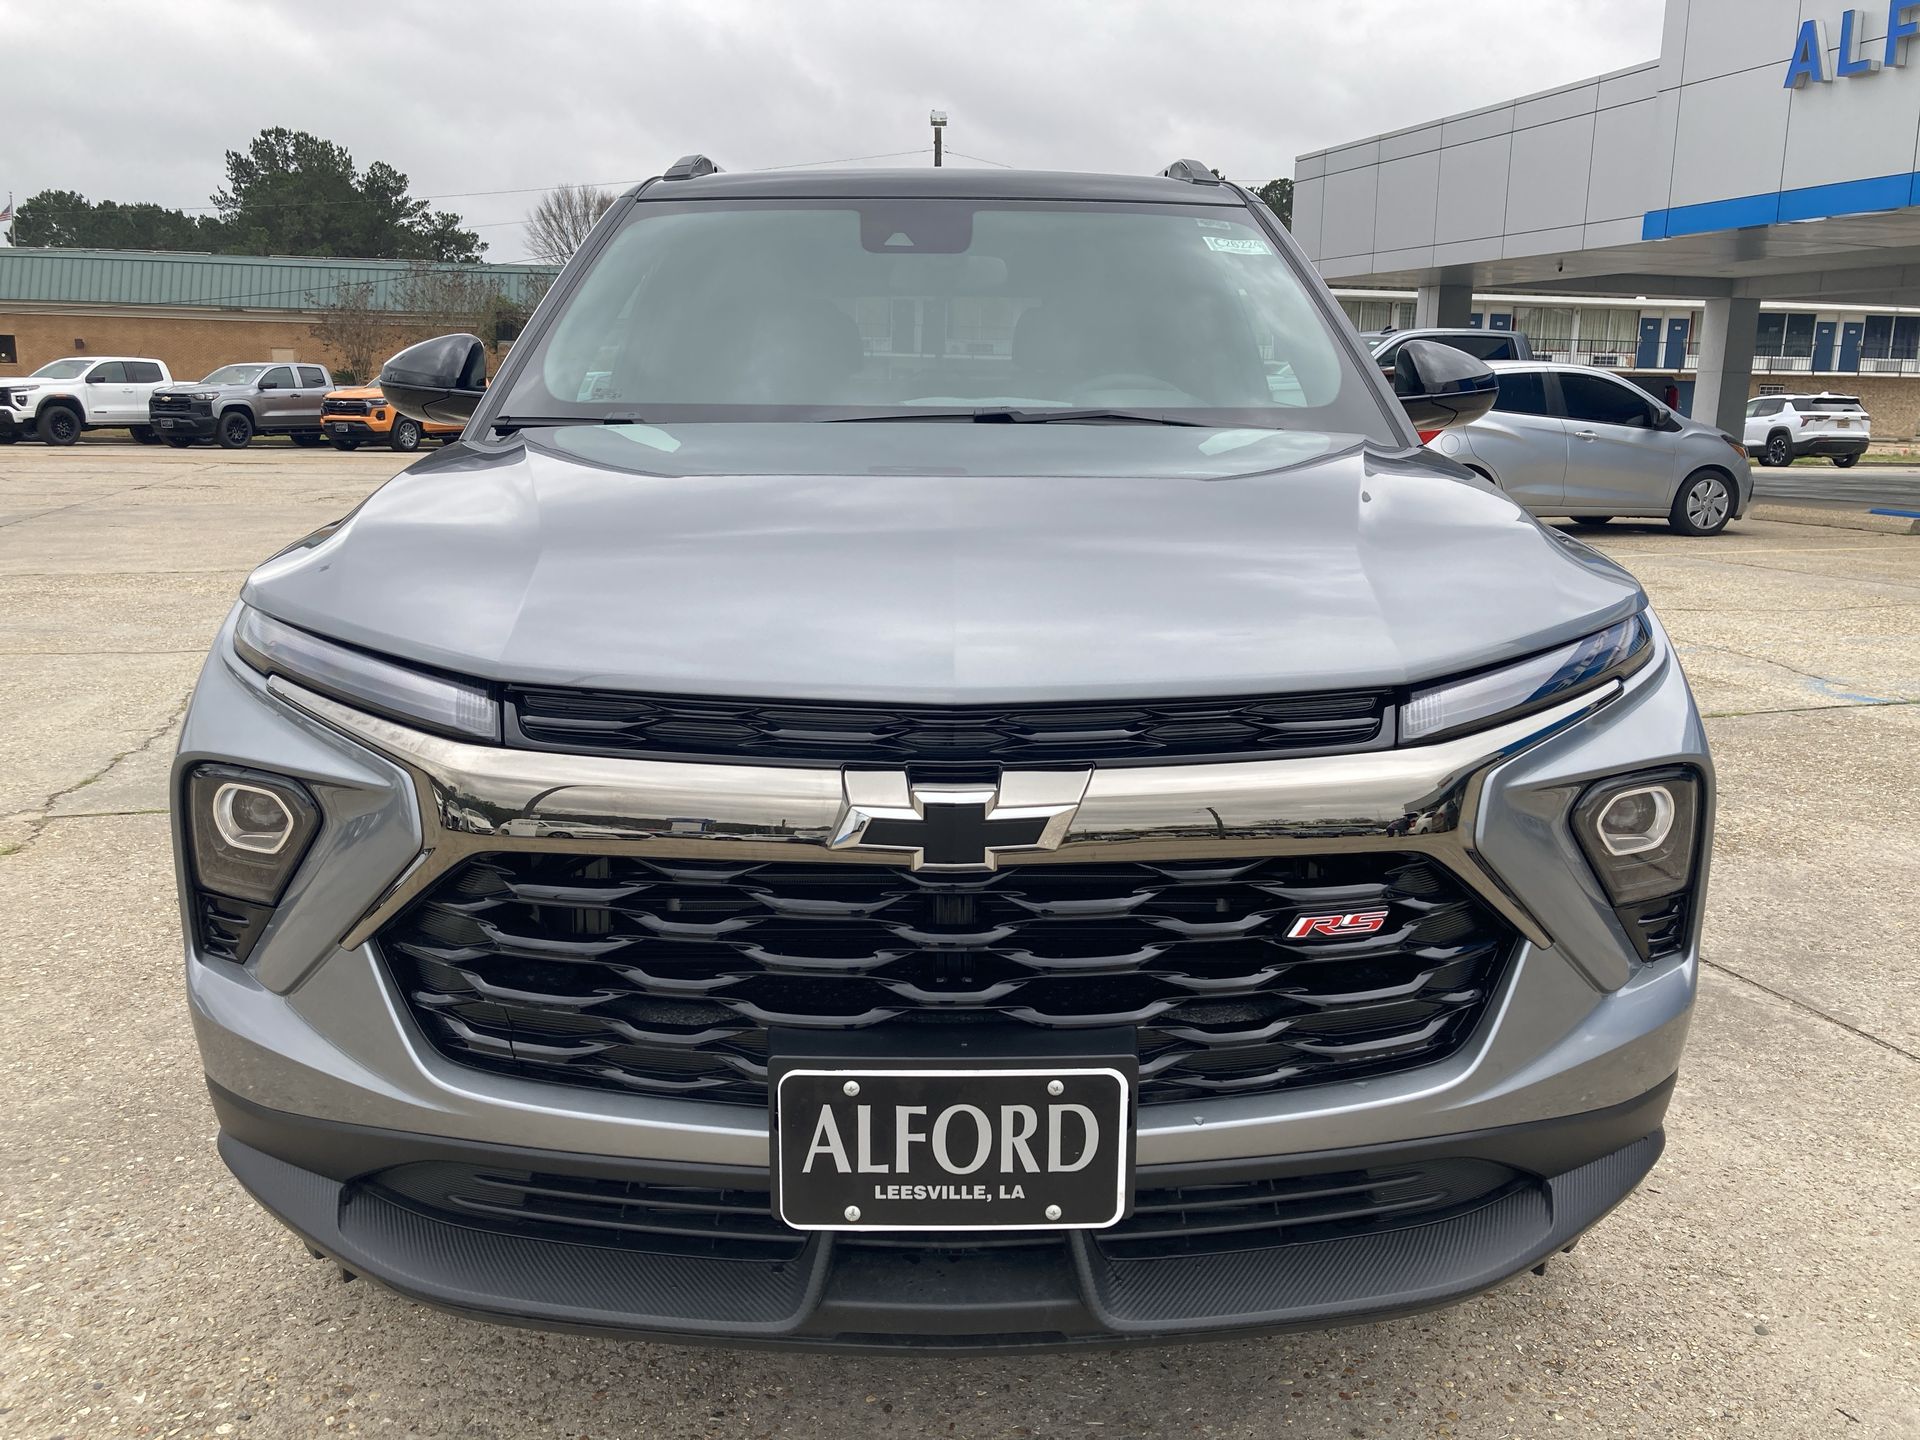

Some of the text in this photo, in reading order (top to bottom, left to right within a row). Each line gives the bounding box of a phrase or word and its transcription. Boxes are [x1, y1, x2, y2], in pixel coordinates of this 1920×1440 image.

[1783, 0, 1920, 88] ALF
[1287, 911, 1389, 938] RS
[802, 1103, 1100, 1175] ALFORD
[874, 1185, 1025, 1202] LEESVILLE, LA
